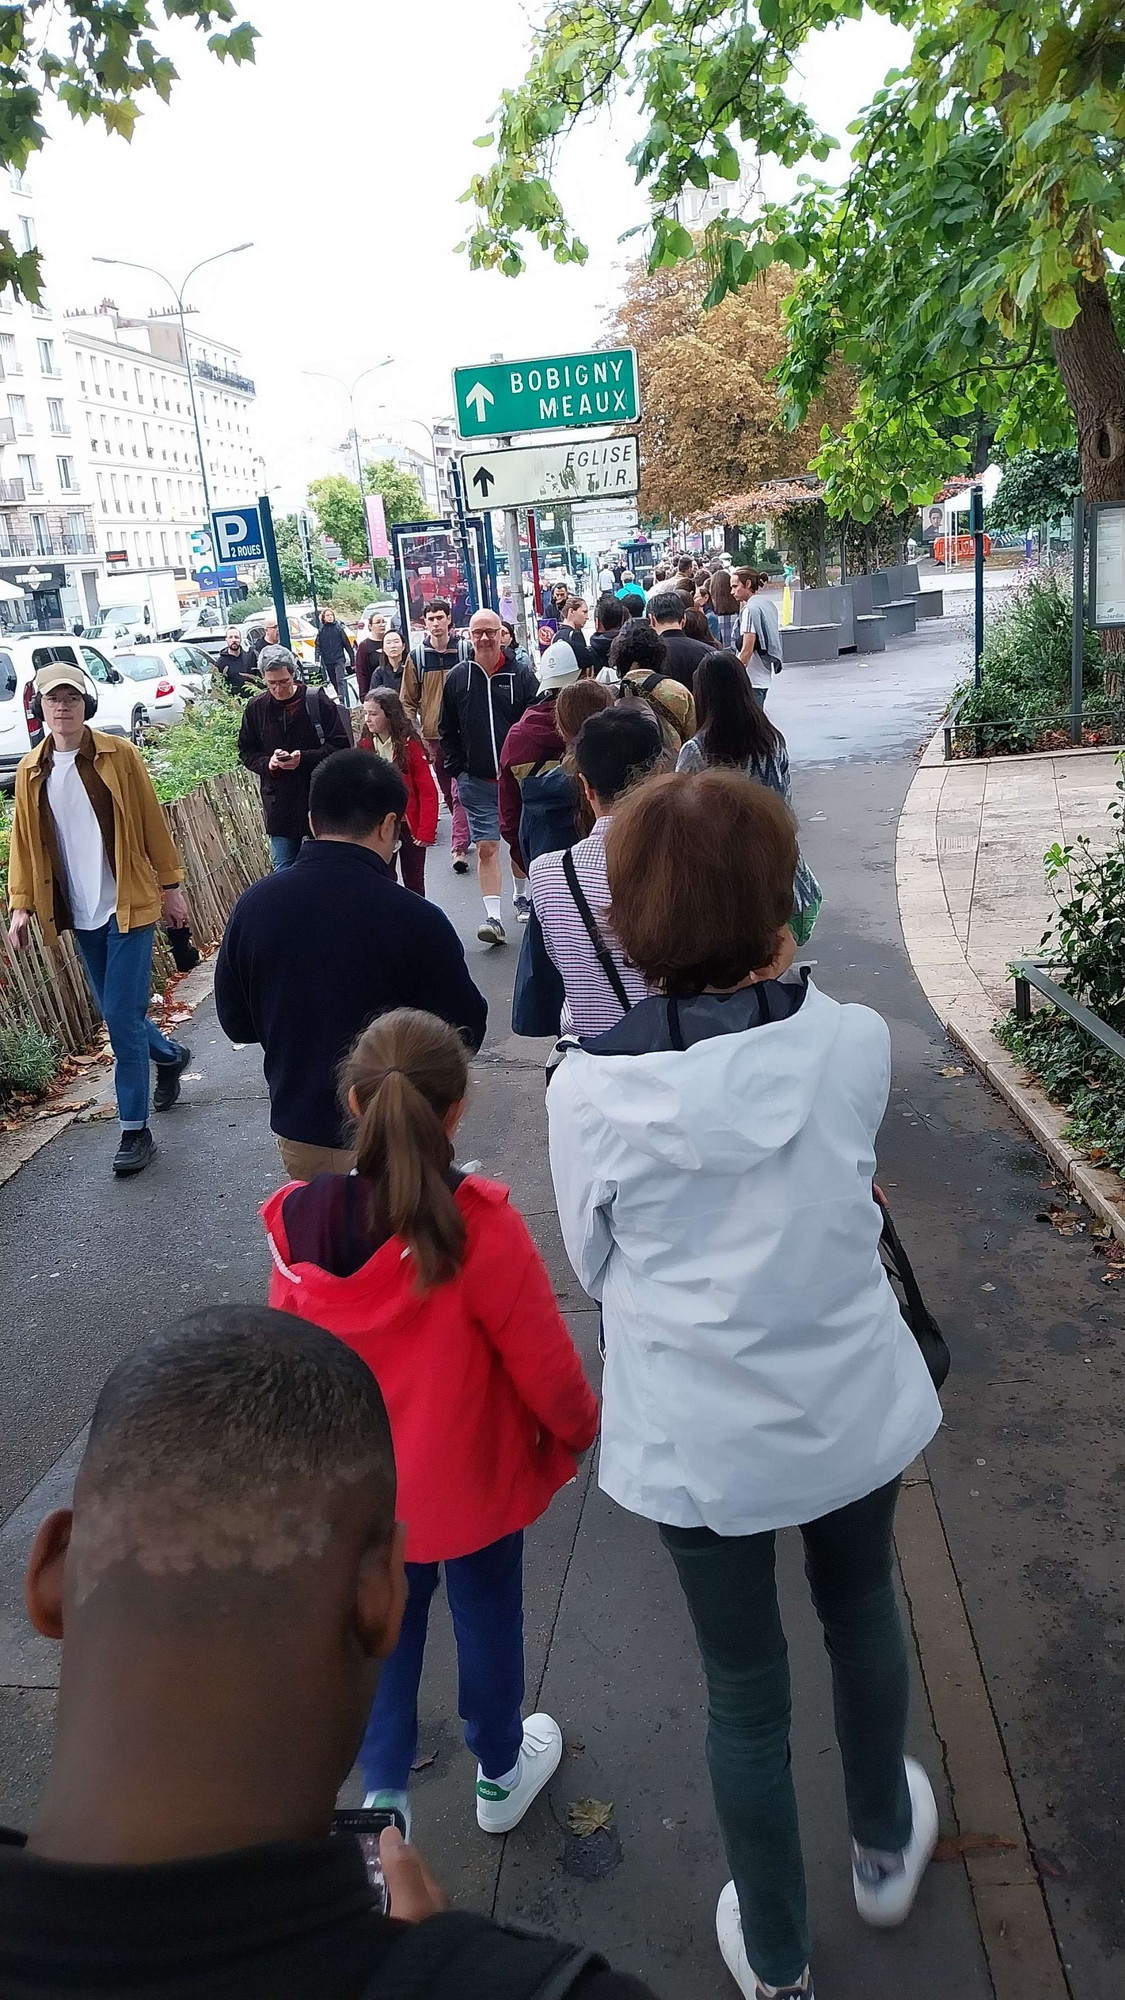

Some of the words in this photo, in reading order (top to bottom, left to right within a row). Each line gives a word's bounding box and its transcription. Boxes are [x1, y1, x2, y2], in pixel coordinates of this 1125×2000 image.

[510, 359, 624, 394] BOBIGNY
[539, 388, 627, 420] MEAUX
[565, 444, 632, 469] EGLISE
[215, 514, 248, 559] P
[230, 548, 237, 558] 2
[237, 544, 262, 558] ROUES
[480, 1787, 498, 1796] adidas
